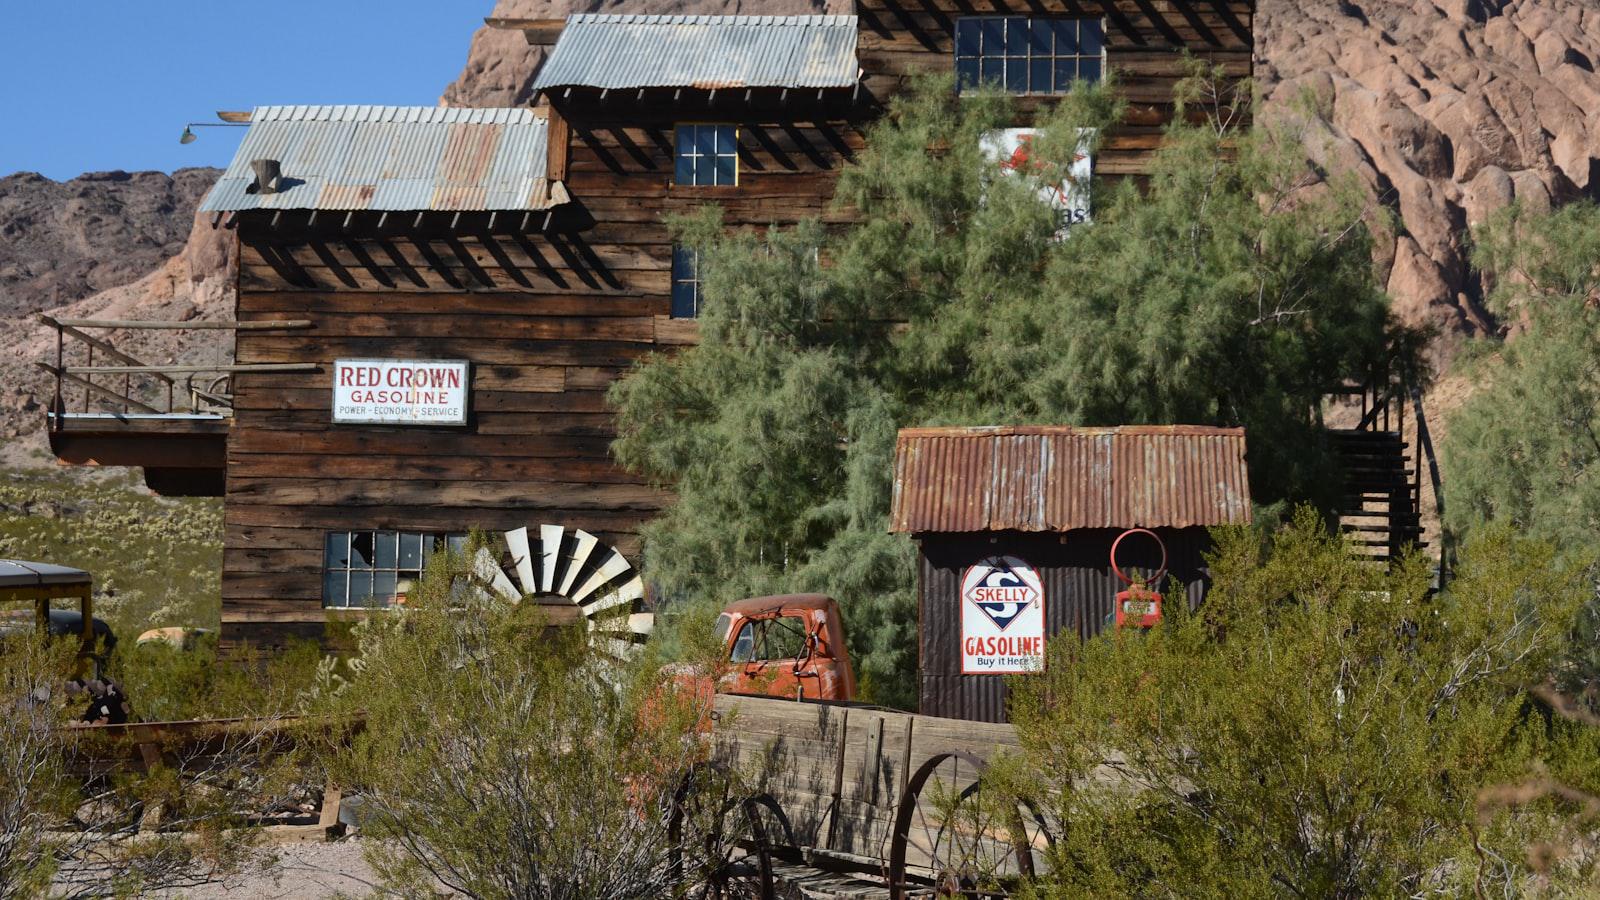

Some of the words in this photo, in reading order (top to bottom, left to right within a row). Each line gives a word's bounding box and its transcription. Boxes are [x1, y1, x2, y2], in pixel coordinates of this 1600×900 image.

[340, 367, 381, 386] RED
[386, 367, 460, 388] CROWN
[351, 391, 448, 404] GASOLINE
[340, 406, 366, 415] POWER
[374, 406, 413, 415] ECONOMY
[421, 408, 458, 416] SERVICE
[975, 588, 1028, 601] SKELLY
[966, 636, 1041, 656] GASOLINE
[977, 657, 996, 668] Buy
